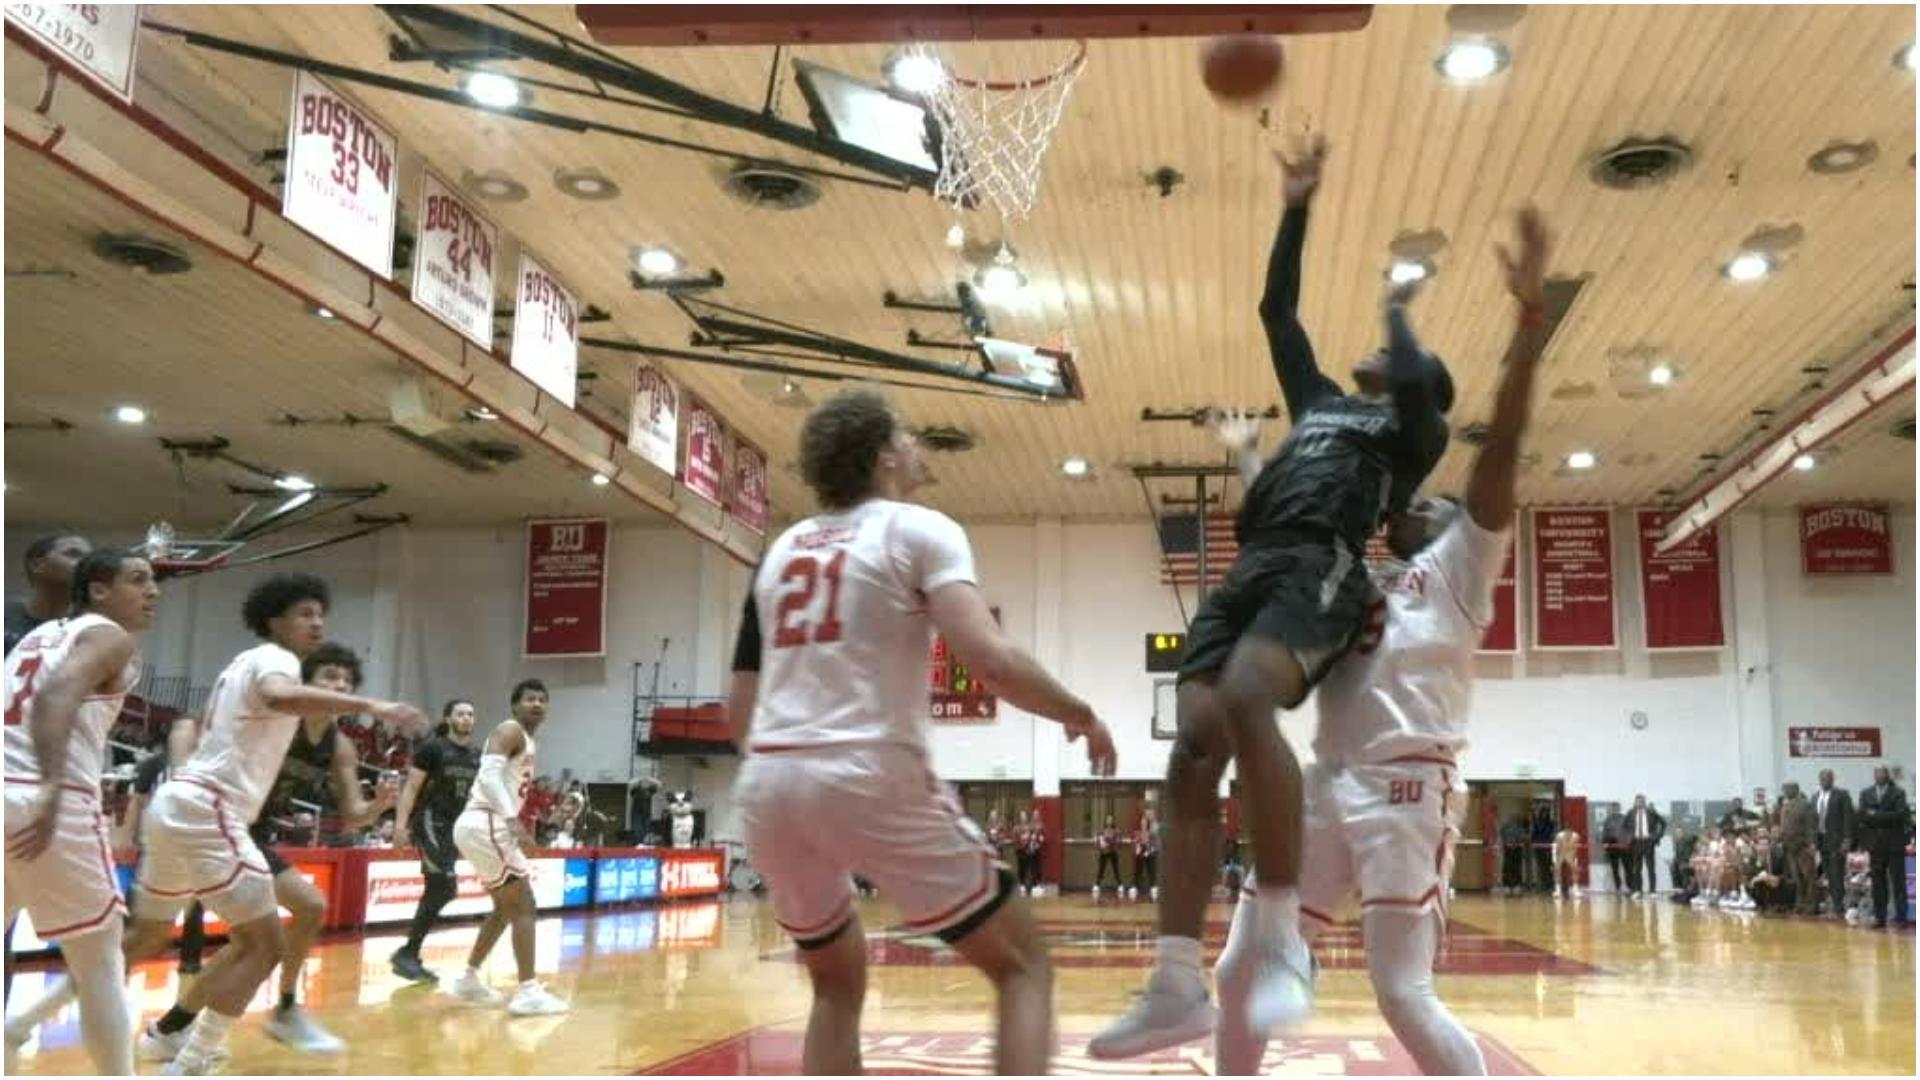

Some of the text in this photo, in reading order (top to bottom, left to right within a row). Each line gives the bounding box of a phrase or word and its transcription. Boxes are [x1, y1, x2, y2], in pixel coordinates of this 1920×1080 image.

[17, 4, 95, 60] 67-1970
[302, 93, 393, 195] BOSTON
[331, 142, 360, 195] 33
[425, 196, 493, 278] BOSTON
[447, 238, 473, 282] 44
[525, 271, 575, 343] BOSTON
[551, 526, 585, 551] BU
[1803, 507, 1886, 537] BOSTON
[774, 549, 847, 648] 21
[1389, 779, 1424, 805] BU
